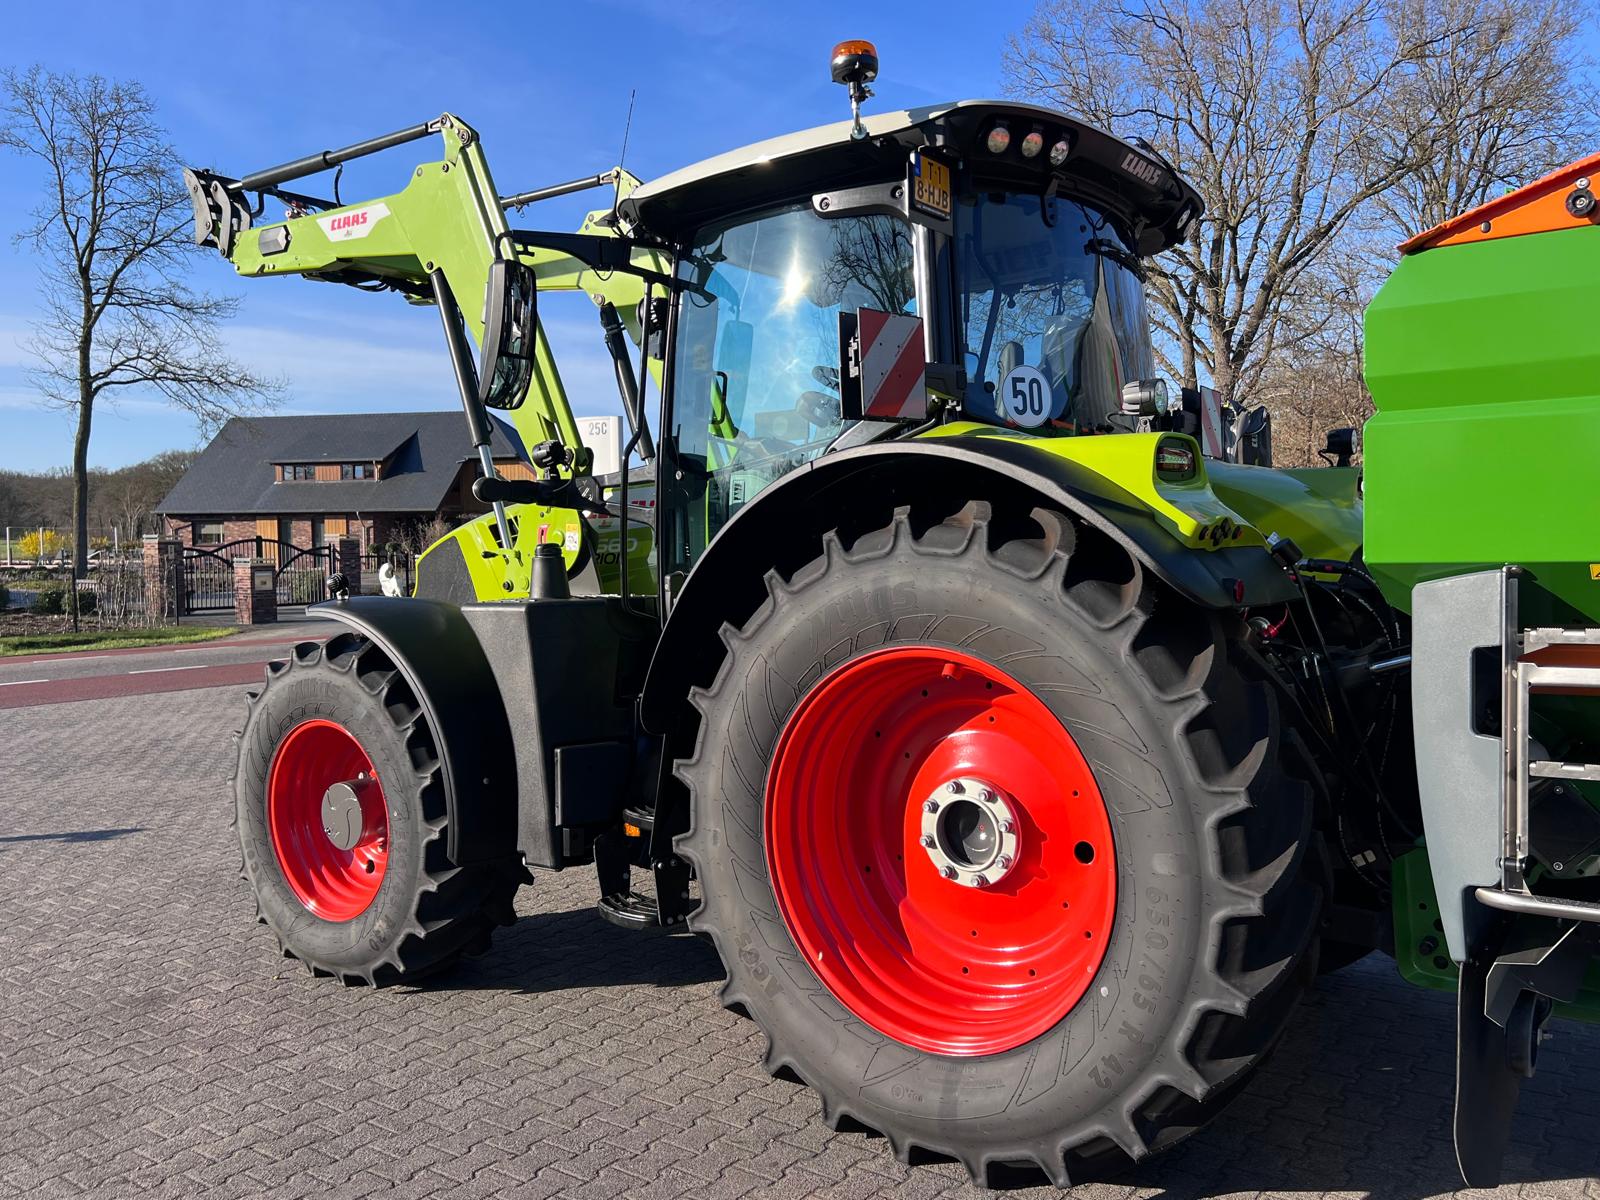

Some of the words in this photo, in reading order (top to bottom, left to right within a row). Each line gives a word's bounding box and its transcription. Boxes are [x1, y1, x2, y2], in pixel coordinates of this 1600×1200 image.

[1120, 153, 1161, 185] CLAAS
[917, 180, 949, 209] 8-HJB
[331, 212, 368, 231] CLAAS
[1011, 377, 1043, 416] 50
[588, 422, 607, 435] 25C
[1132, 886, 1170, 1015] 650/65
[1087, 1053, 1125, 1089] 42
